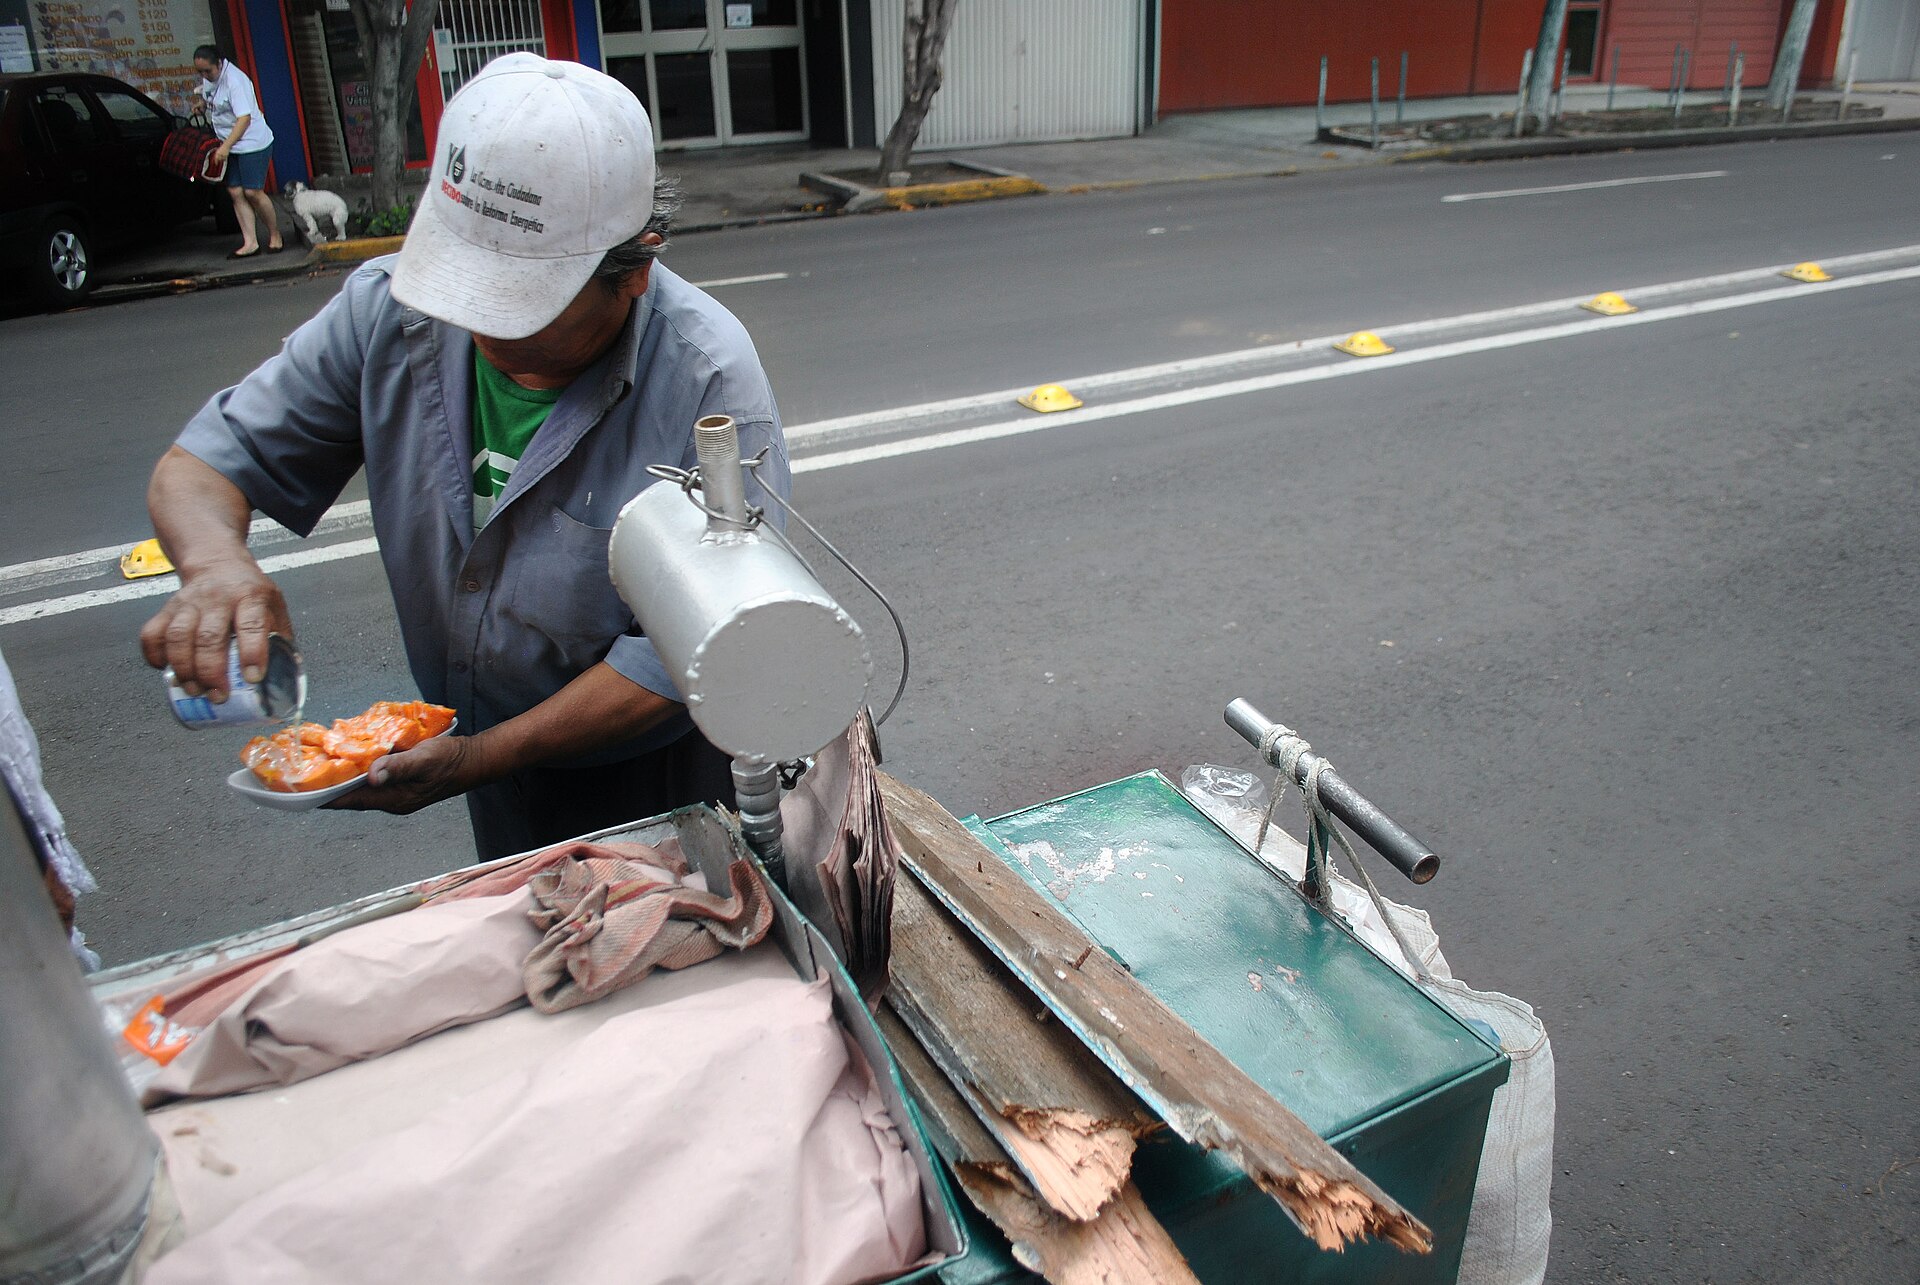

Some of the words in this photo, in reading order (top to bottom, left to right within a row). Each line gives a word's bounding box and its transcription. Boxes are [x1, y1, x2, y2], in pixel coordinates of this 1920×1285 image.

[138, 9, 168, 20] $120
[145, 33, 174, 44] $200
[441, 178, 462, 203] DECIDO
[482, 200, 508, 223] Reforma
[507, 182, 542, 206] Ciudadana
